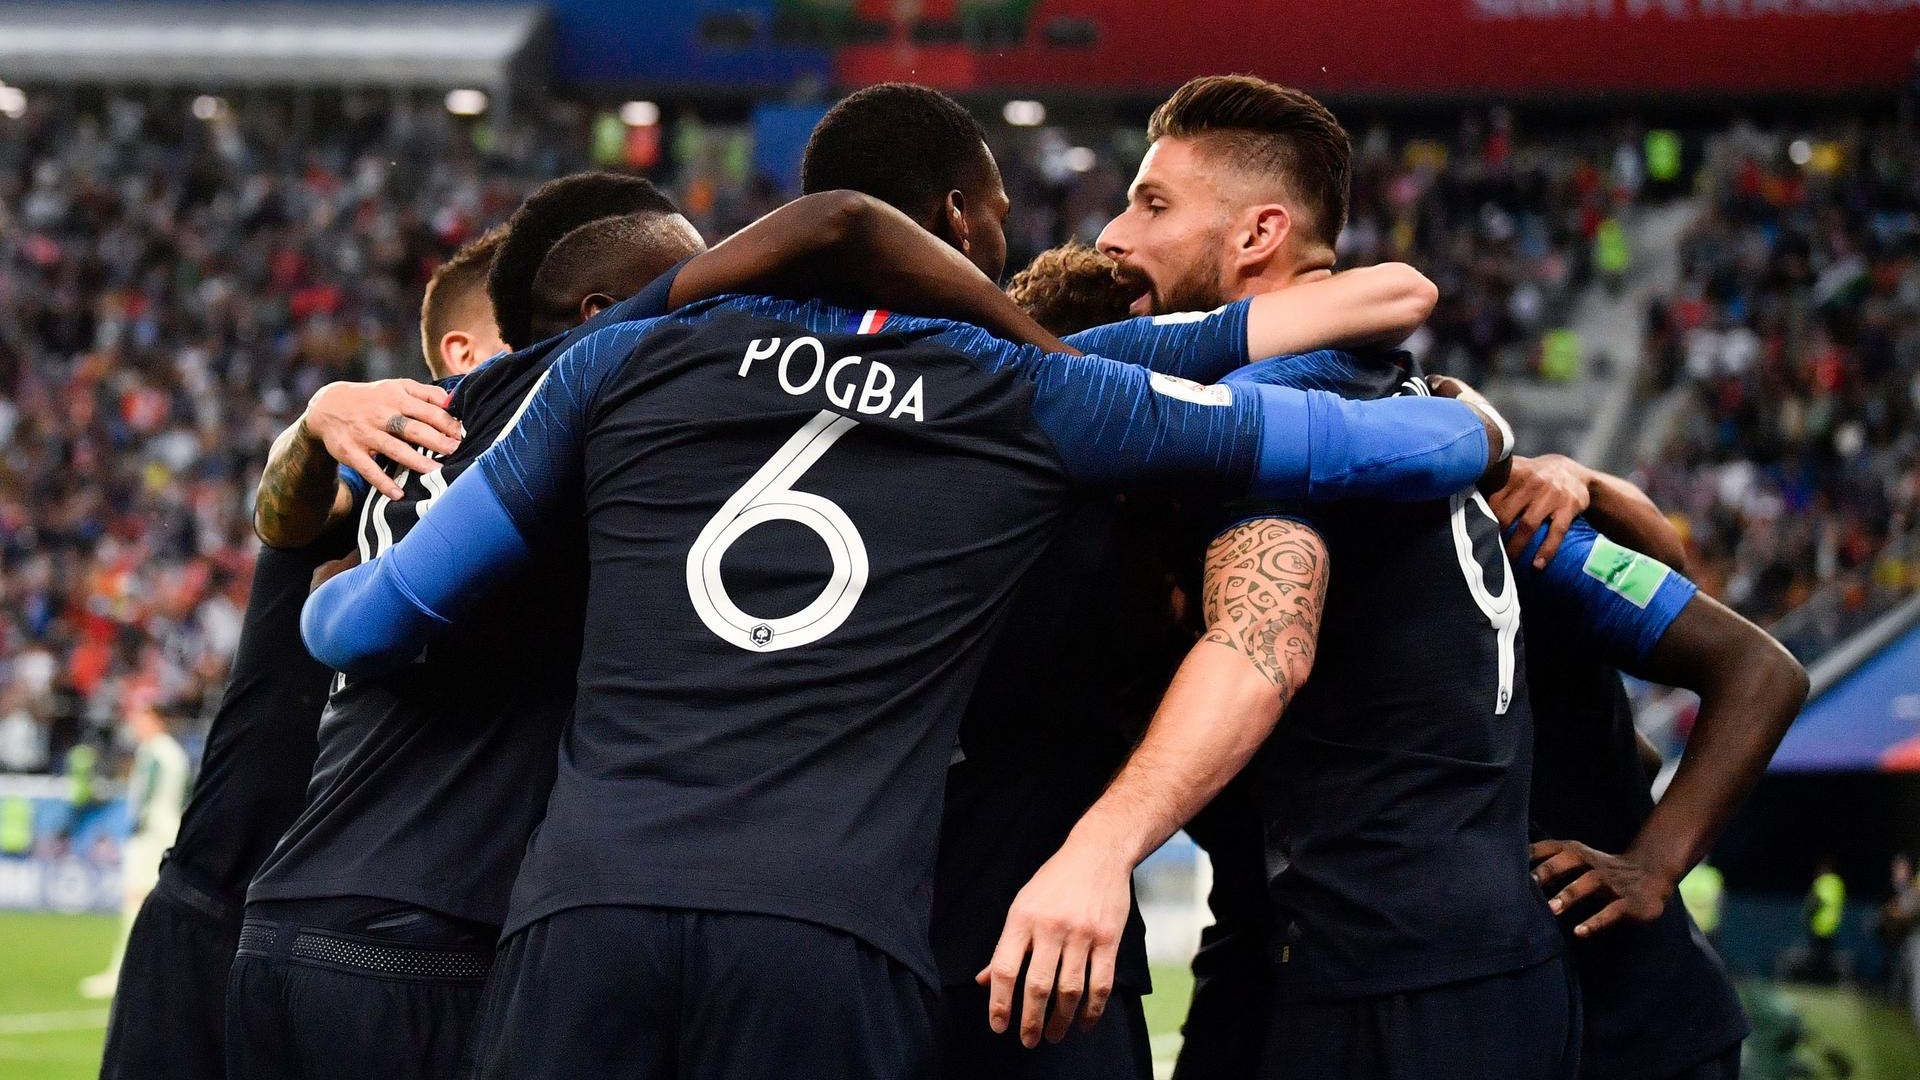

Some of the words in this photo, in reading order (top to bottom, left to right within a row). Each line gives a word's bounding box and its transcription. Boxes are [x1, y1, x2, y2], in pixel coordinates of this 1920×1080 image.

[737, 337, 925, 422] POGBA
[686, 409, 869, 652] 6
[1450, 489, 1521, 715] 9
